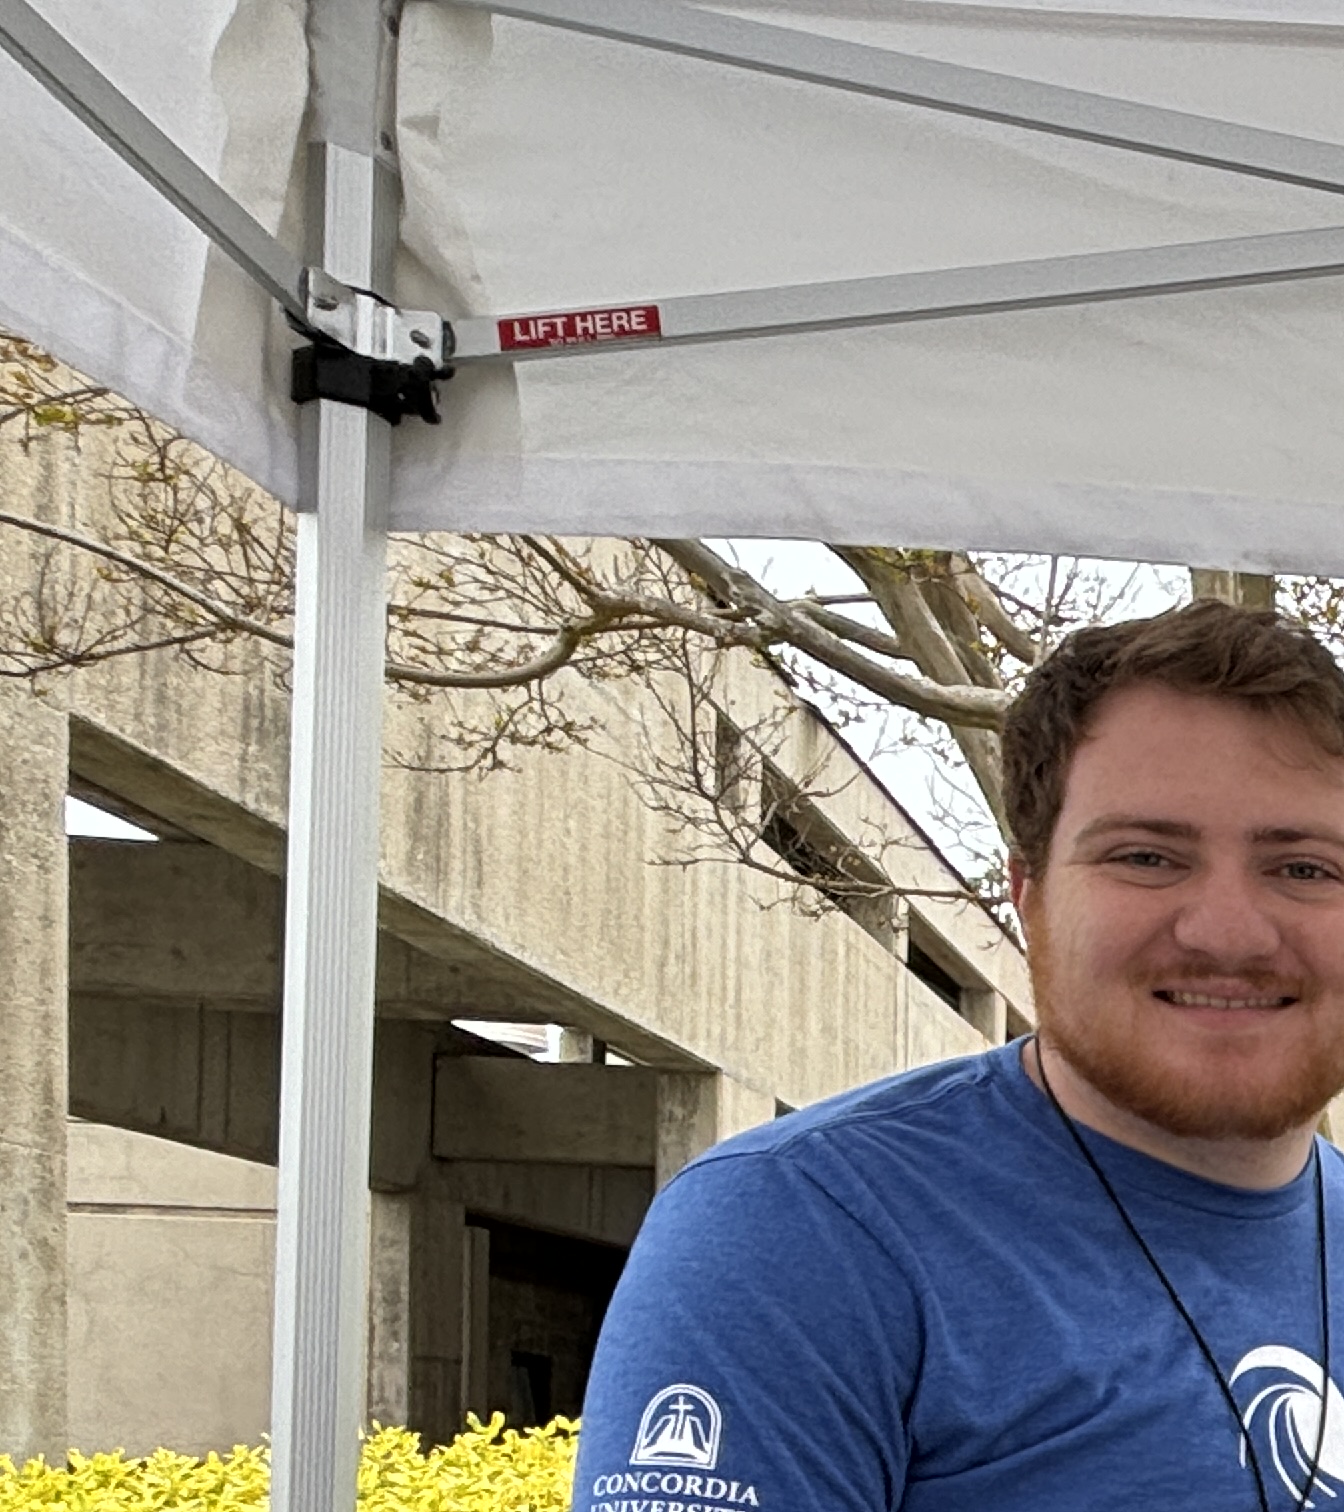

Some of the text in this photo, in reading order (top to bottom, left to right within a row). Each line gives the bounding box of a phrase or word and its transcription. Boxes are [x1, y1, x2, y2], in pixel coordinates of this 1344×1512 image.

[513, 316, 567, 341] LIFT
[575, 310, 648, 335] HERE
[592, 1471, 760, 1507] CONCORDIA
